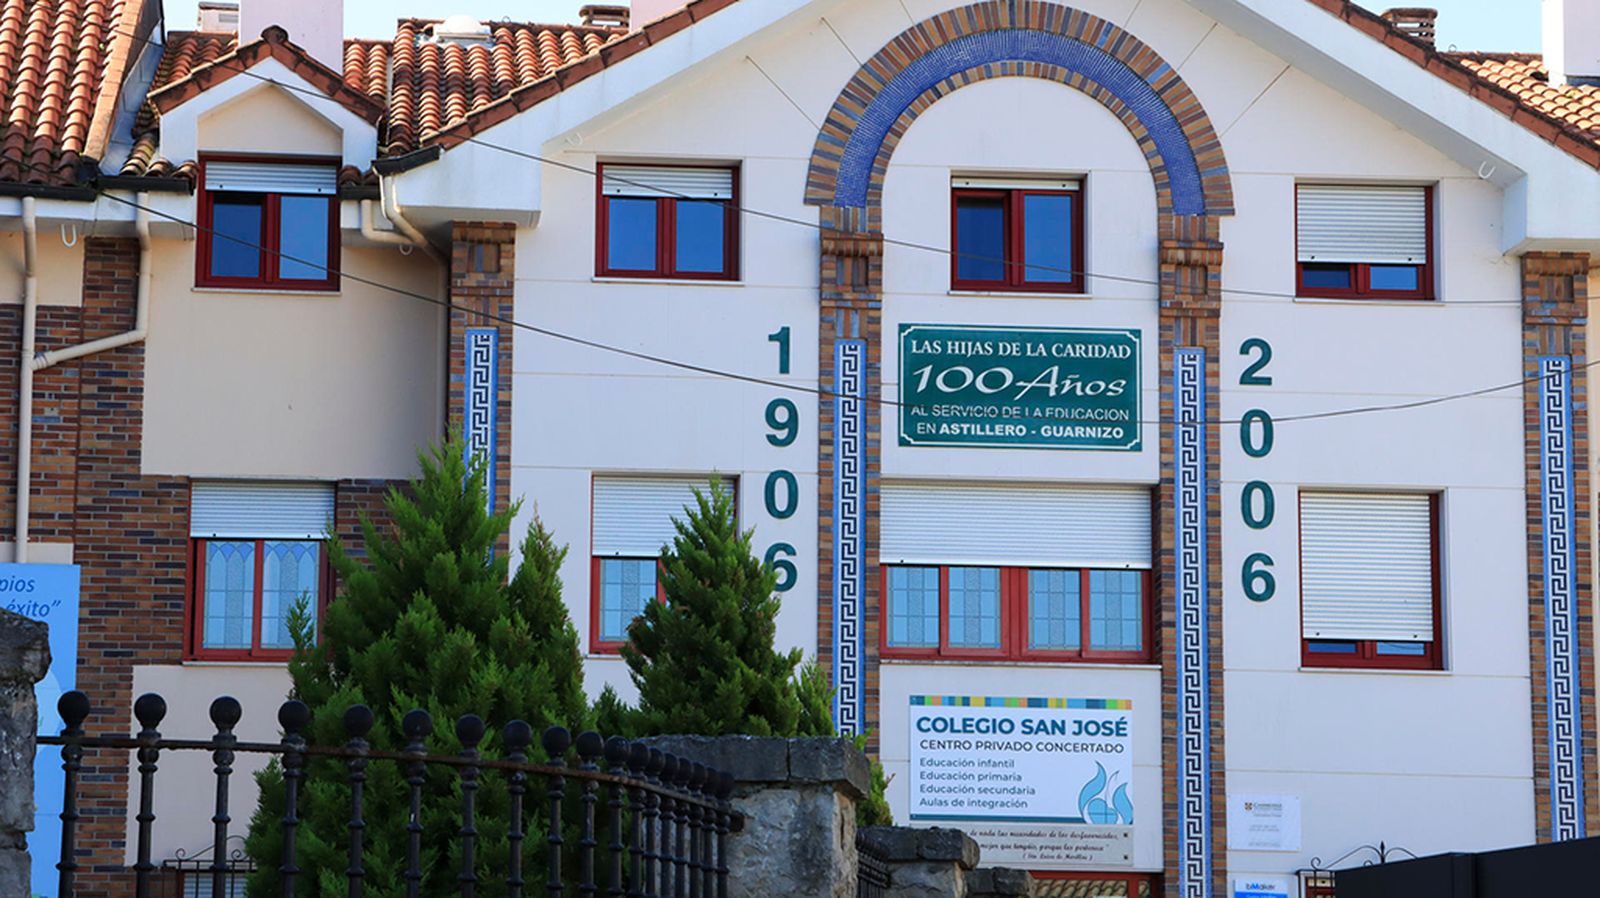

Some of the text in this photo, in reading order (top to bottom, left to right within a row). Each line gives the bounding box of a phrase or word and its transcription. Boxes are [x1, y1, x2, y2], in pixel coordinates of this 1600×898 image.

[911, 340, 1131, 358] LAS HIJAS DE LA CARIDAD
[913, 364, 1127, 400] 100 Años
[911, 405, 1129, 420] AL SERVICIO DE LA EDUCACION
[917, 423, 936, 434] EN
[939, 423, 1026, 436] ASTILLERO
[1040, 425, 1124, 438] GUARNIZO
[1238, 338, 1276, 602] 2006
[916, 716, 1128, 737] COLEGIO SAN JOSÉ
[920, 740, 1124, 754] CENTRO PRIVADO CONCERTADO
[920, 757, 1015, 768] Educación infantil
[920, 771, 1022, 784] Educación primaria
[920, 784, 1036, 795] Educación secundaria
[920, 798, 1028, 810] Aulas de integración
